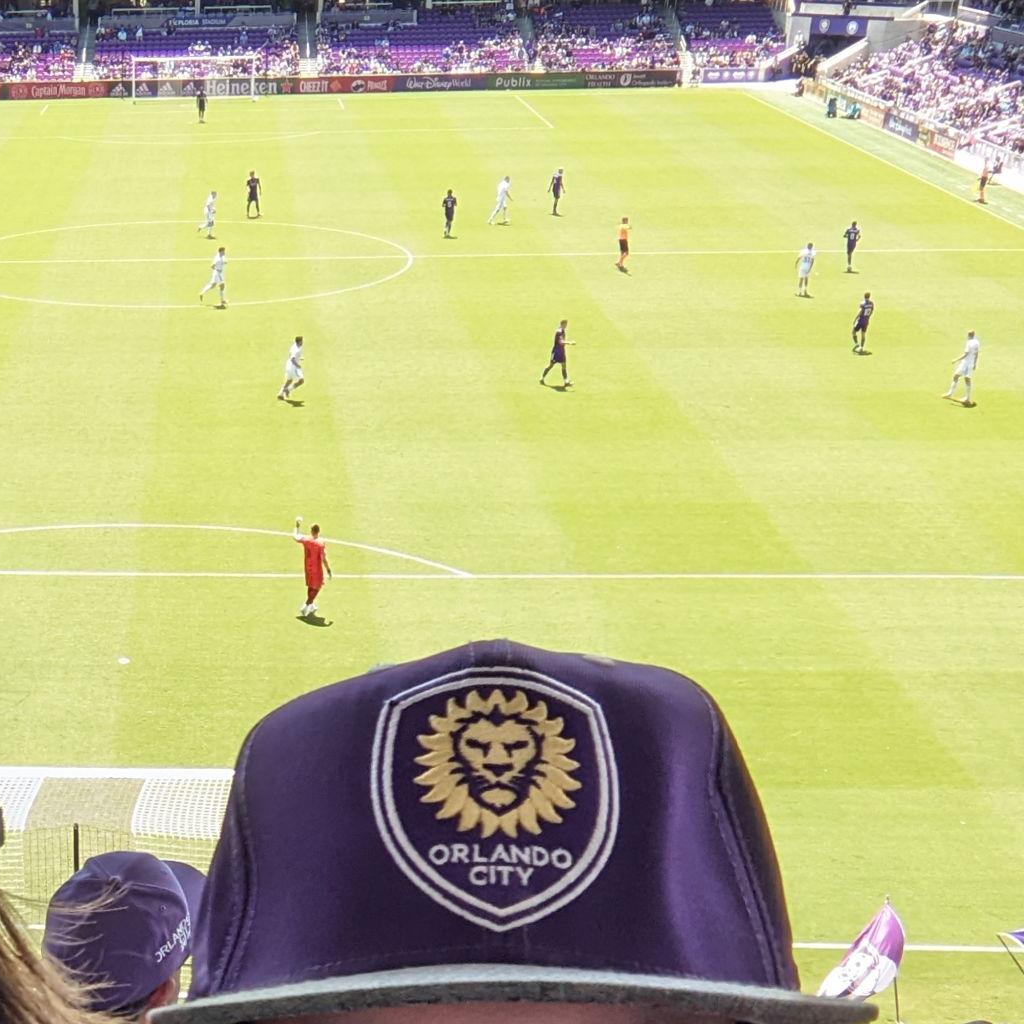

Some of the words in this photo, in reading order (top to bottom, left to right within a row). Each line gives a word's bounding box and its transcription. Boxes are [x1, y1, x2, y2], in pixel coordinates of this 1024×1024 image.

[206, 79, 277, 95] Heineken
[495, 76, 532, 88] Publix
[428, 843, 573, 870] ORLANDO
[468, 866, 535, 886] CITY
